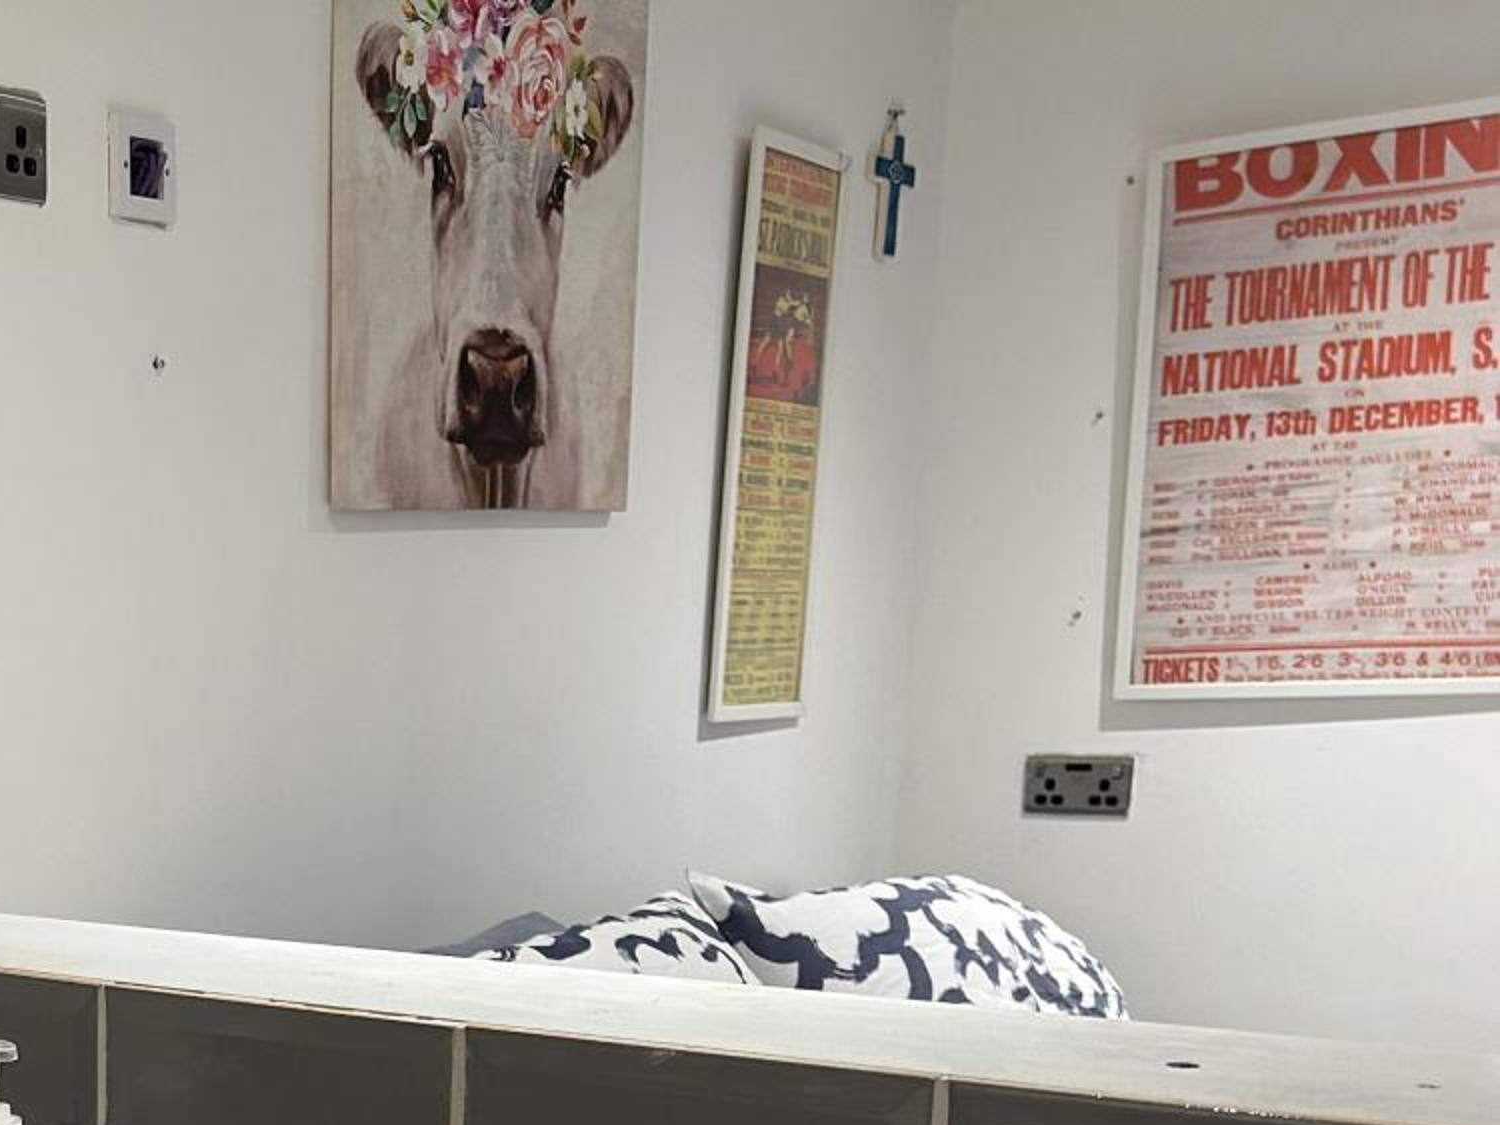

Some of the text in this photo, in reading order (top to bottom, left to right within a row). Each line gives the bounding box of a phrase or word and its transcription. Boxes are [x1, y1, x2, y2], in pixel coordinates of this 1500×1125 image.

[1169, 242, 1496, 334] THE TOURNAMENT OF THE
[1160, 345, 1301, 398] NATIONAL
[1265, 408, 1317, 439] 13th
[1142, 656, 1221, 685] TICKETS
